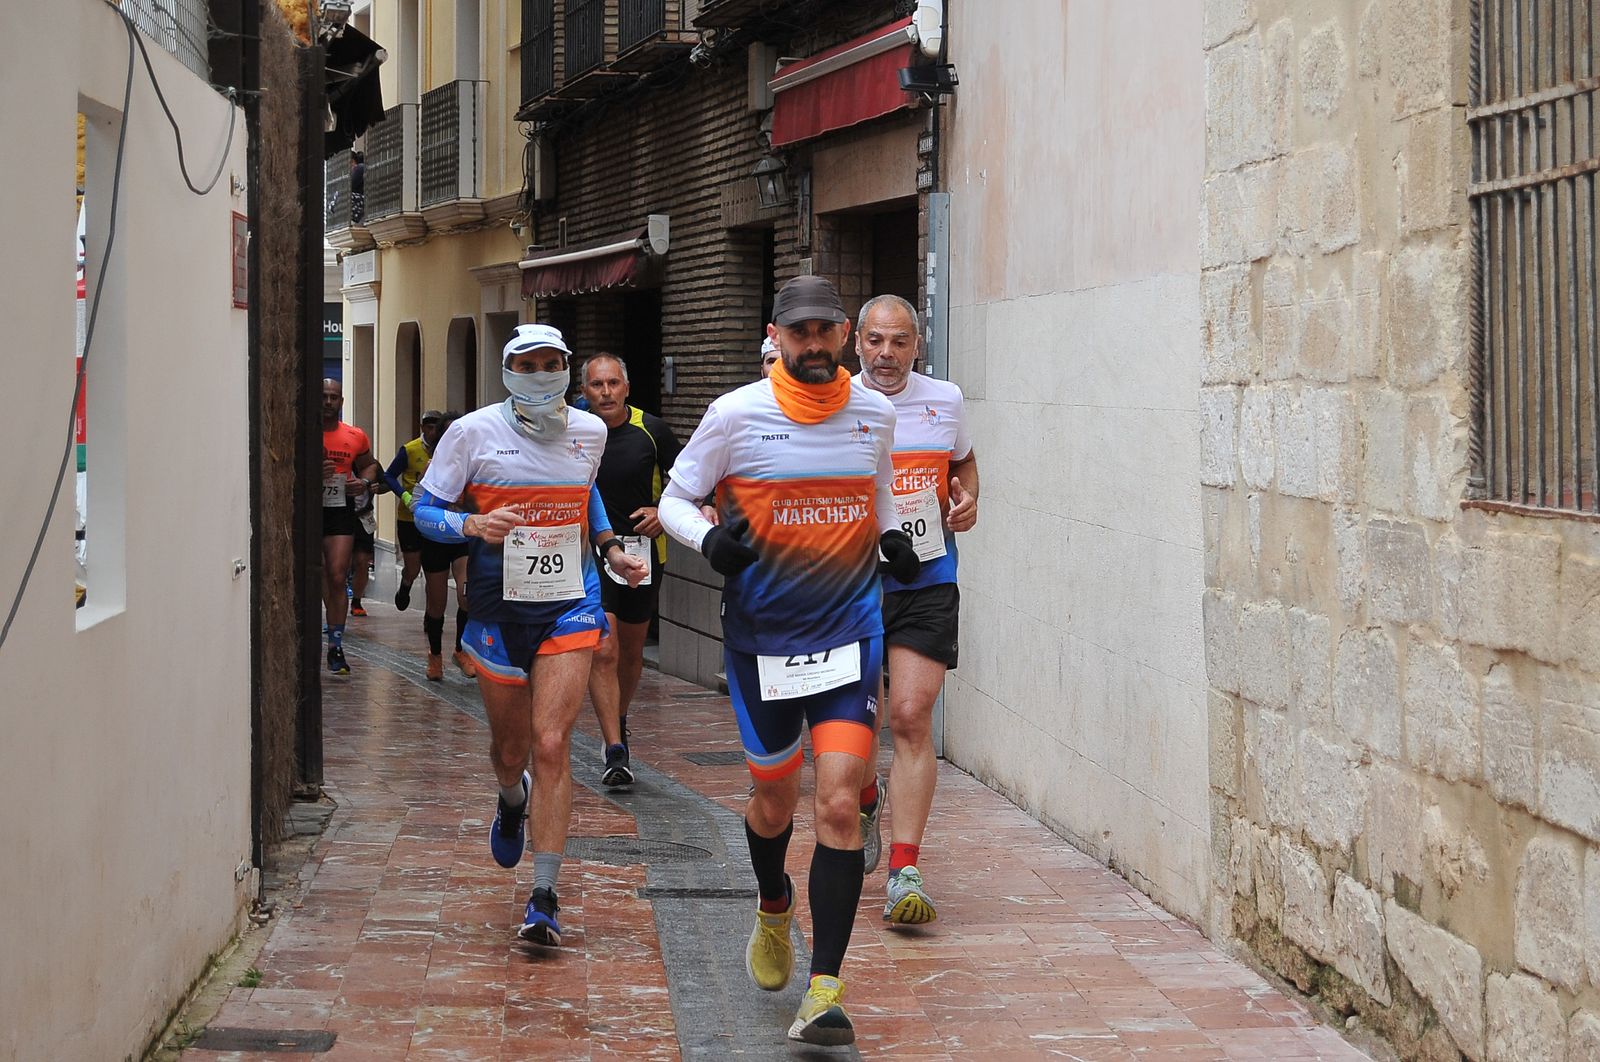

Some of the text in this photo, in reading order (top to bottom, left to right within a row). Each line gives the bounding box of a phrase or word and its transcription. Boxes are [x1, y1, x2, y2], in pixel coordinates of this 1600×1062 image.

[772, 499, 792, 507] CLUB
[794, 497, 833, 506] ATLETISMO
[772, 504, 868, 526] MARCHENA
[525, 553, 564, 576] 789
